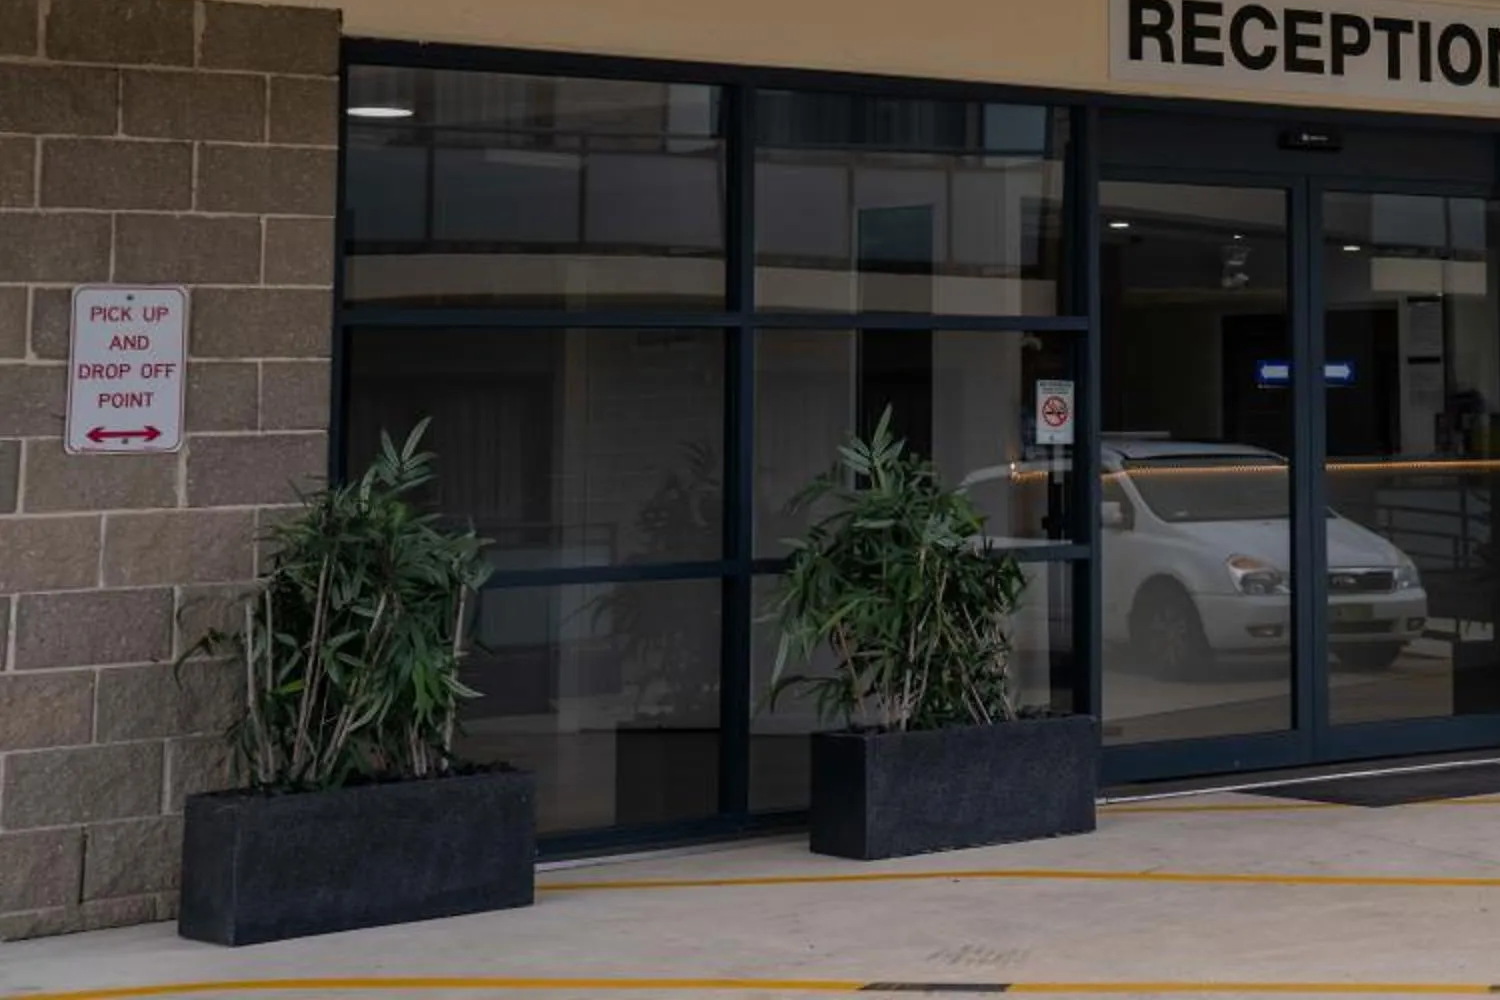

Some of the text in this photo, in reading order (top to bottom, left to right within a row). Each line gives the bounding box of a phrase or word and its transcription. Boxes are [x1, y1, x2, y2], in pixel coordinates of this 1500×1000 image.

[90, 306, 169, 322] PICK UP
[109, 335, 149, 350] AND
[77, 363, 176, 379] DROP OFF
[98, 392, 154, 408] POINT
